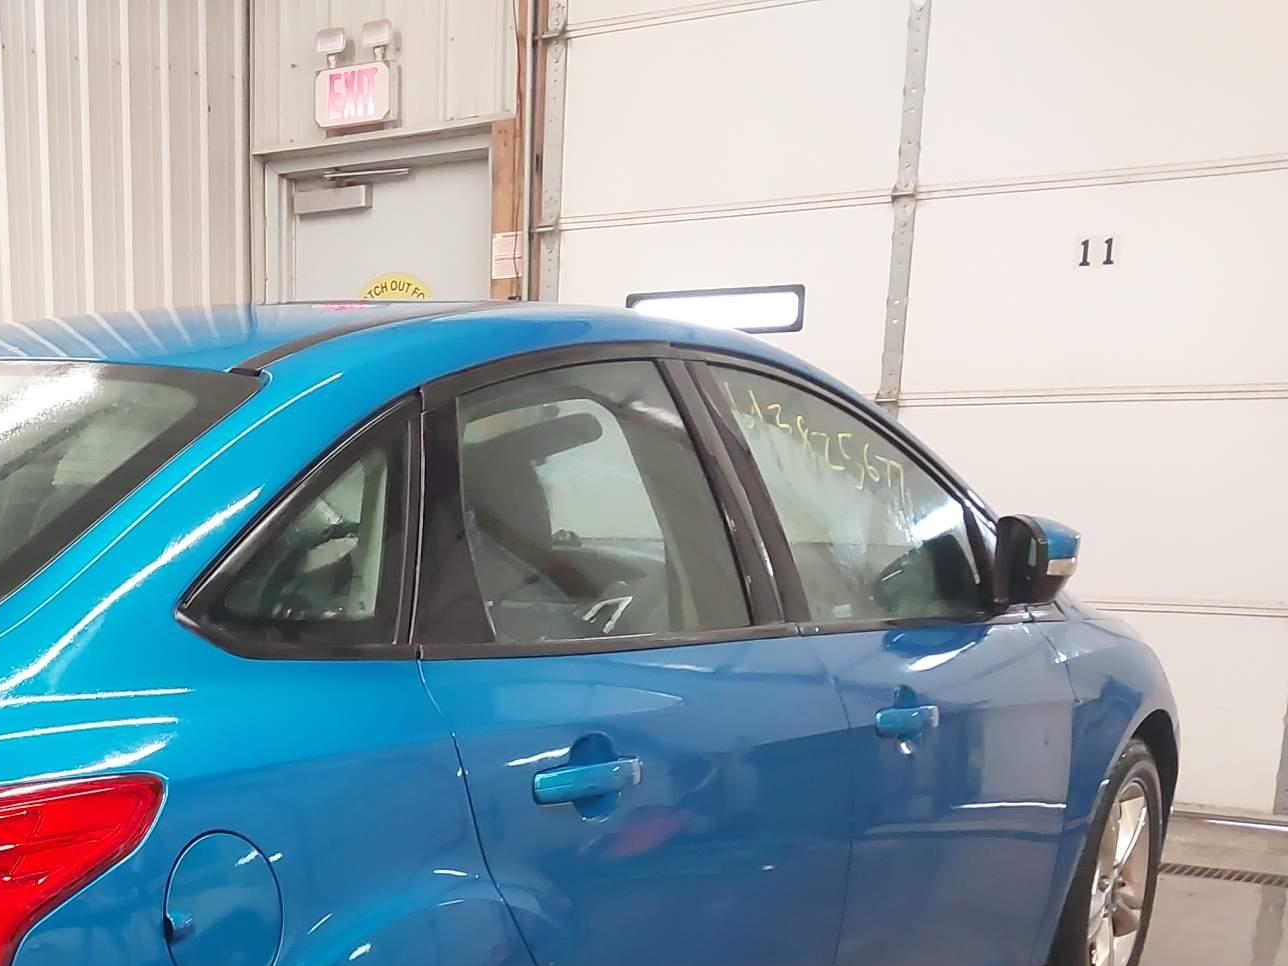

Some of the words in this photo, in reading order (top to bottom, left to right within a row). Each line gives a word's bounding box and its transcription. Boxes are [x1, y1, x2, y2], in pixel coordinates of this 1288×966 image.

[328, 67, 378, 119] EXIT
[1078, 237, 1114, 267] 11
[390, 279, 412, 293] OUT
